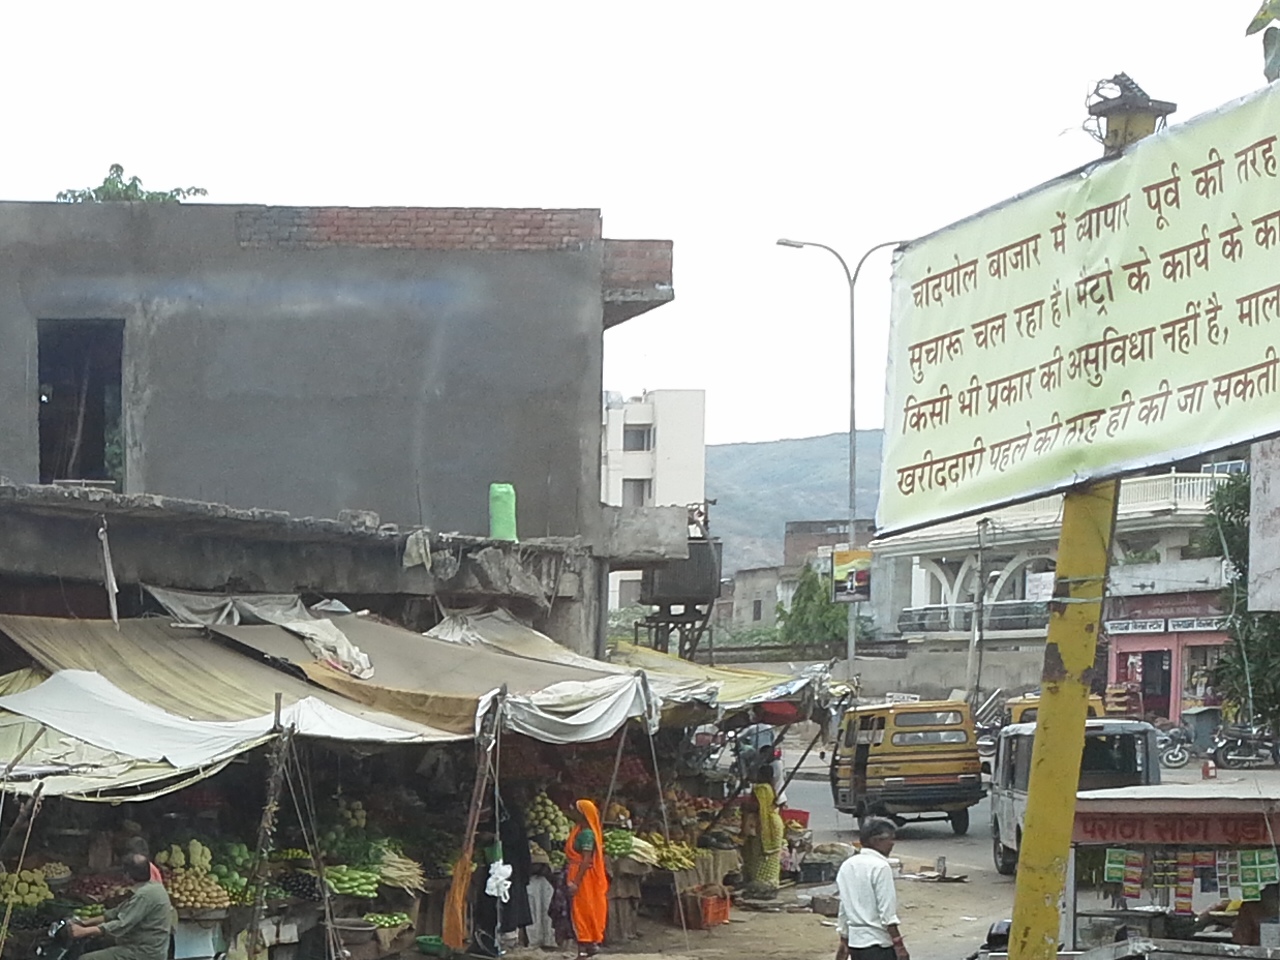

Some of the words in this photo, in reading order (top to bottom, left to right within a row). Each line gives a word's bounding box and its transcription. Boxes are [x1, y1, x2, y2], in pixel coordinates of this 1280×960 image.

[908, 328, 965, 384] सुचारू
[971, 313, 1007, 349] चल
[1014, 300, 1045, 338] रहा
[1121, 246, 1151, 294] के
[1160, 223, 1210, 283] कार्य
[1219, 212, 1243, 262] के
[911, 253, 978, 308] चांदपोल
[986, 234, 1041, 279] बाजार
[1050, 211, 1066, 254] में
[1075, 193, 1131, 241] व्यापार
[1142, 162, 1181, 230] पूर्व
[1191, 148, 1225, 198] की
[1234, 135, 1277, 183] तरह
[896, 436, 986, 496] खरीददारी
[989, 421, 1032, 472] पहले
[1033, 412, 1063, 455] की
[1063, 409, 1106, 445] तरह
[1107, 389, 1135, 437] ही
[1138, 379, 1173, 426] की
[1177, 380, 1208, 414] जा
[1212, 346, 1280, 409] सकती
[902, 384, 952, 435] किसी
[958, 374, 982, 417] भी
[986, 368, 1036, 413] प्रकार
[1039, 346, 1063, 392] की
[1067, 326, 1156, 387] असुविधा
[1160, 300, 1201, 354] नहीं
[1205, 292, 1228, 345] है,
[1236, 284, 1280, 327] माल
